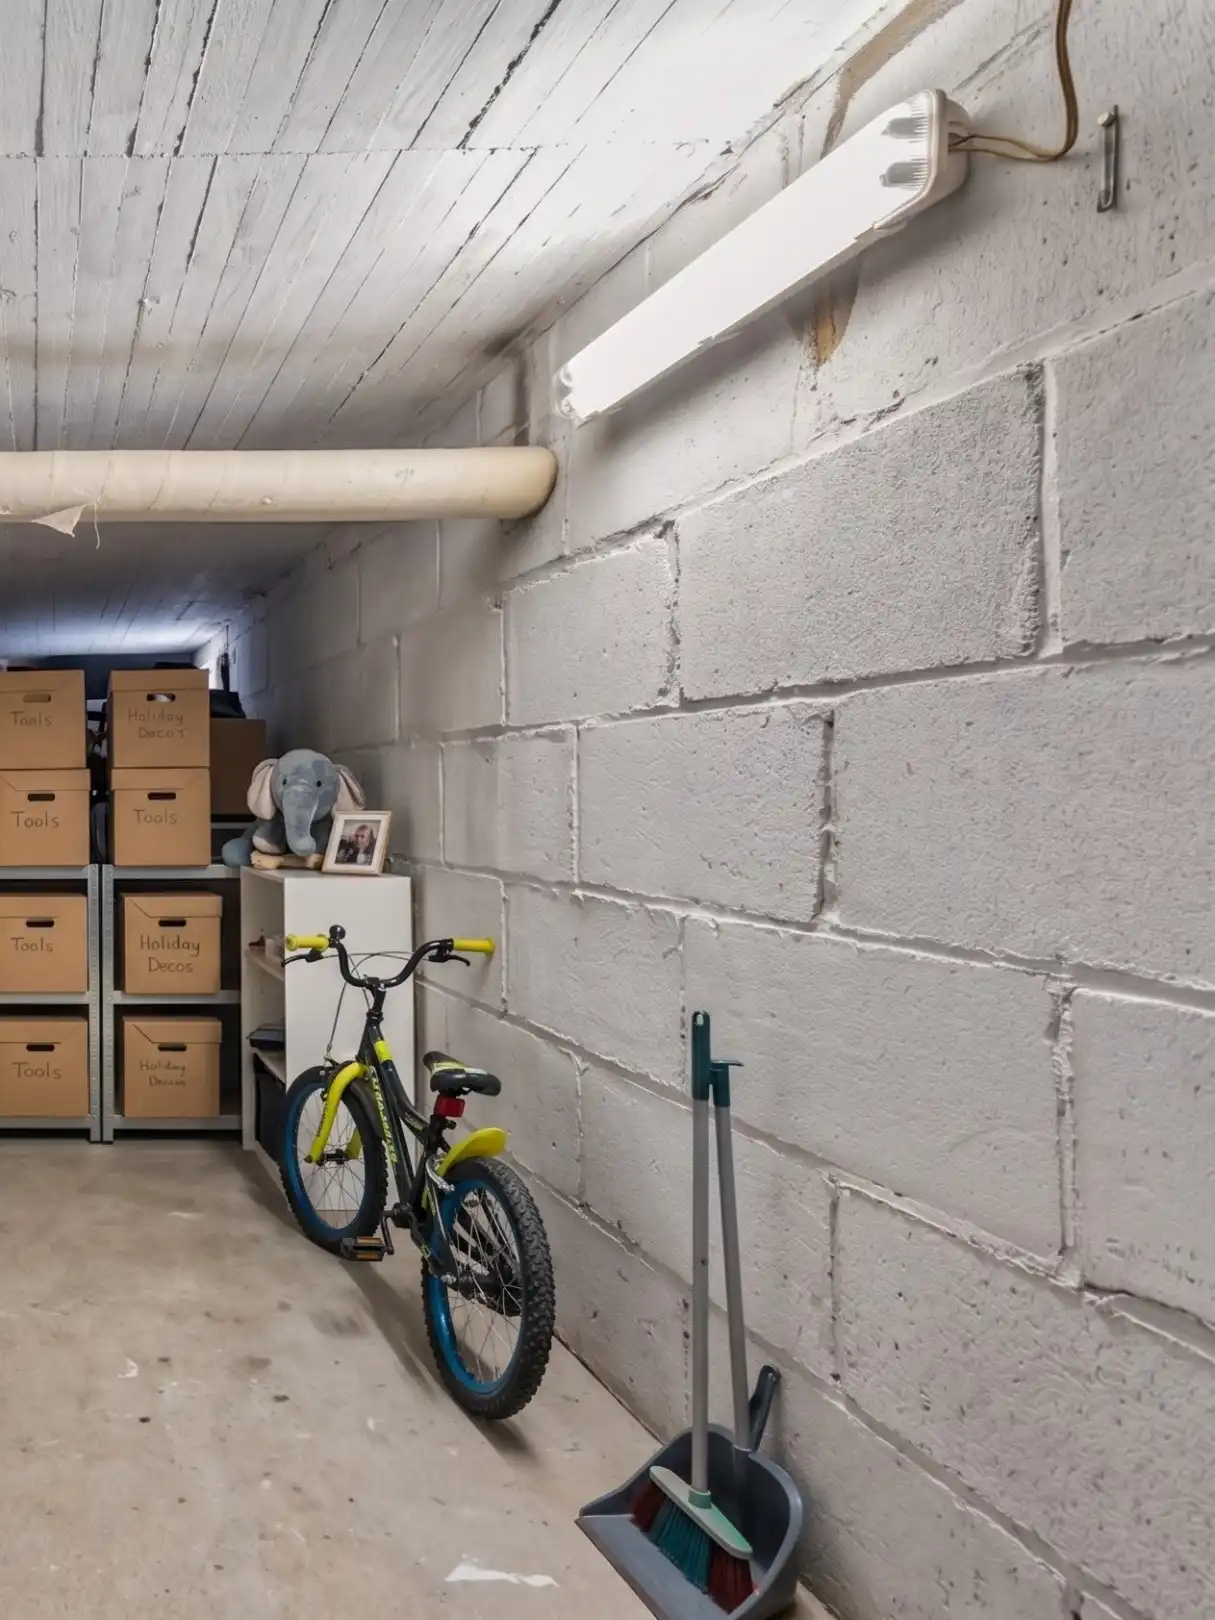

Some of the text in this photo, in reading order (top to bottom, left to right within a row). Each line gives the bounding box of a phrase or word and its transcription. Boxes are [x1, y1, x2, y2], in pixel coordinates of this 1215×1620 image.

[10, 710, 52, 727] Tools
[10, 810, 60, 828] Tools
[132, 807, 178, 824] Tools
[10, 936, 54, 952] Tools
[140, 933, 201, 958] Holiday
[11, 1061, 62, 1080] Tools
